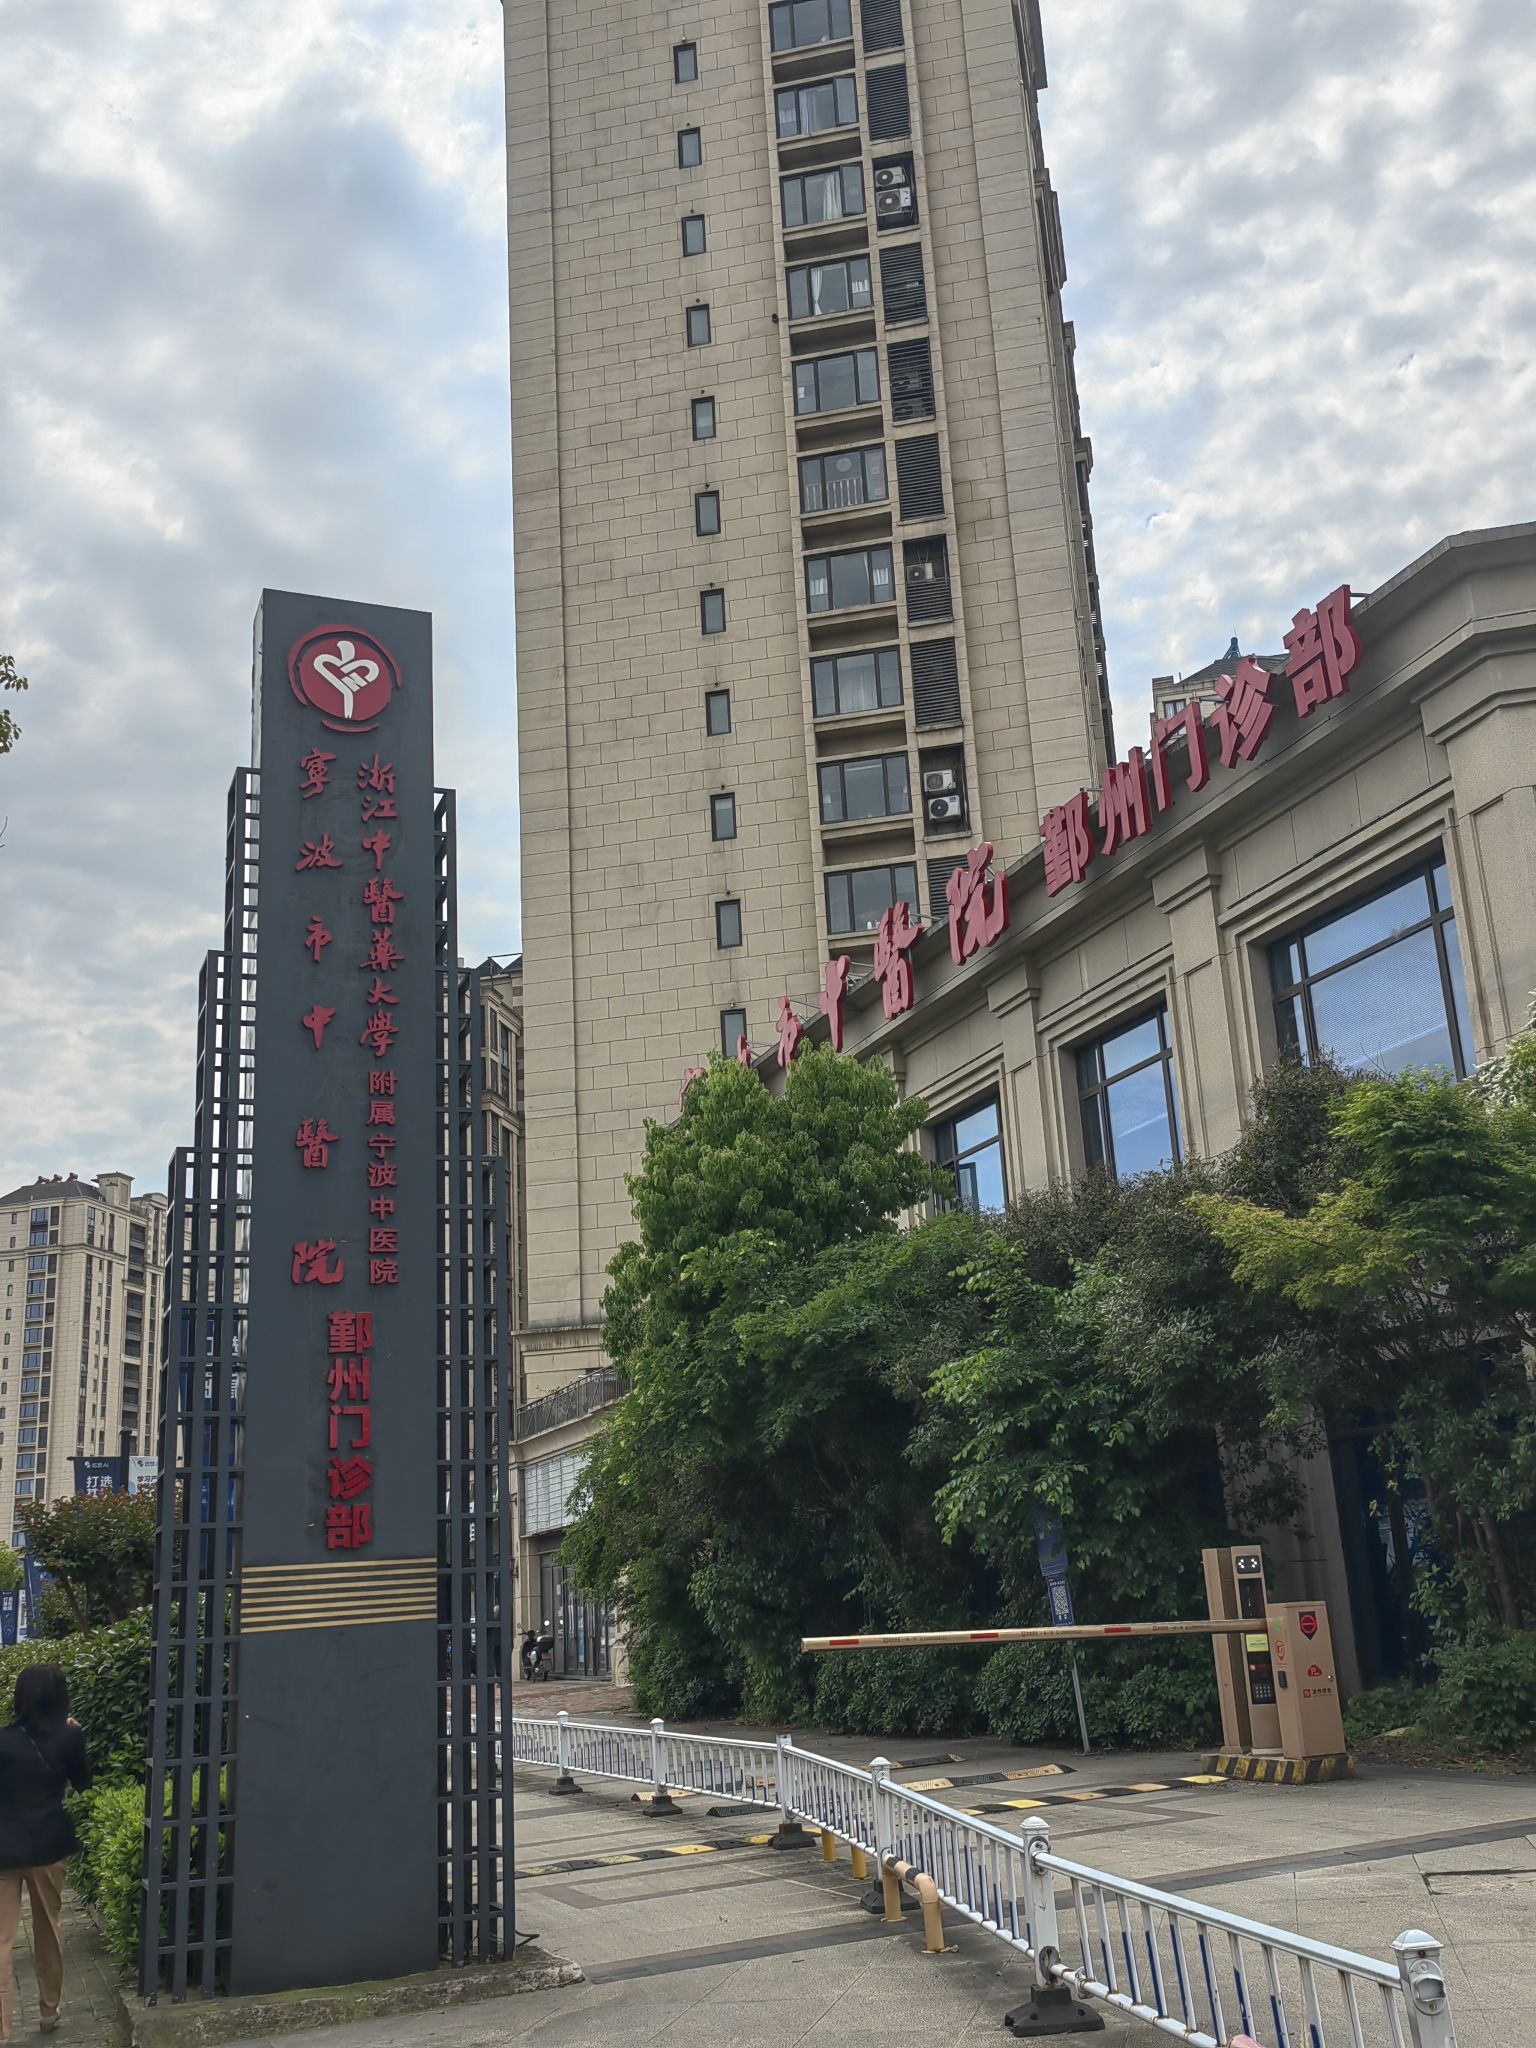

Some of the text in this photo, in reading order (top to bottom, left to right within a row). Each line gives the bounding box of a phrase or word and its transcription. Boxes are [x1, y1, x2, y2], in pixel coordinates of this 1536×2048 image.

[325, 1311, 374, 1551] 鄞州门诊部
